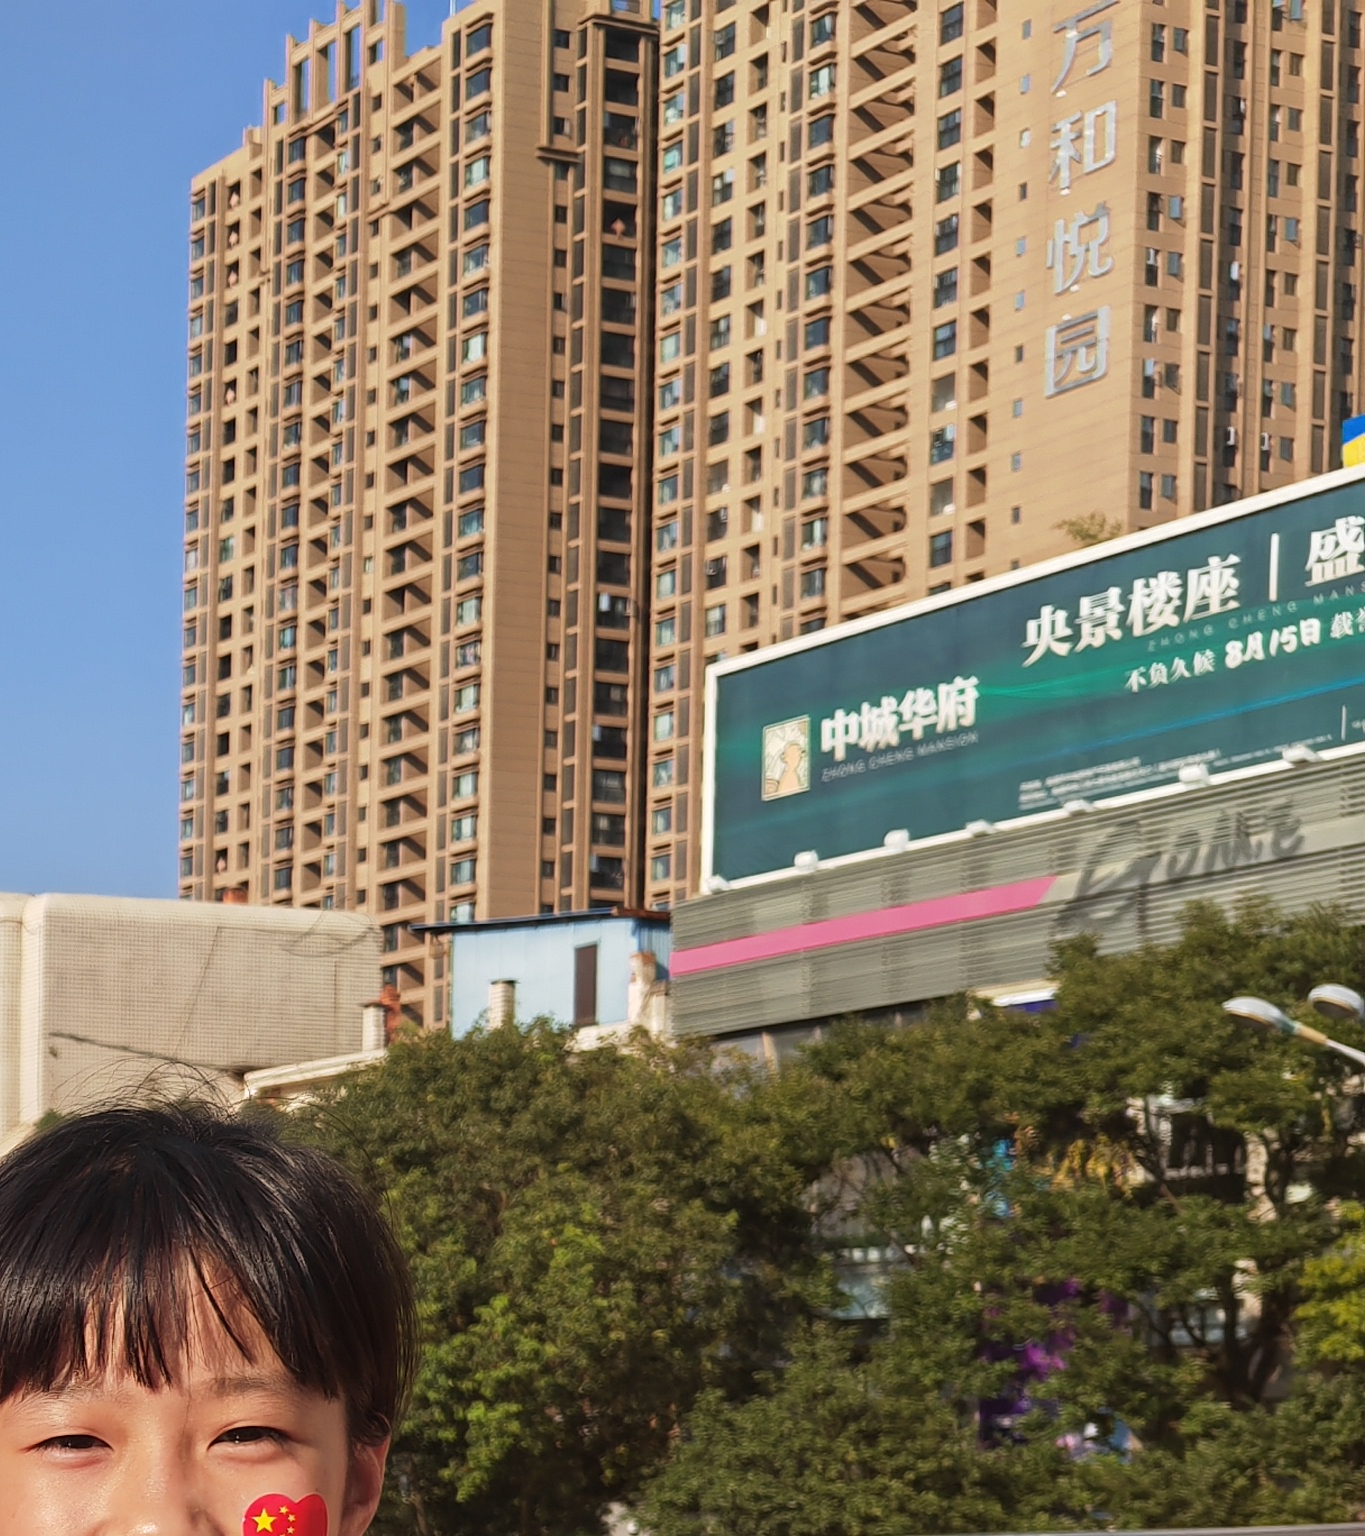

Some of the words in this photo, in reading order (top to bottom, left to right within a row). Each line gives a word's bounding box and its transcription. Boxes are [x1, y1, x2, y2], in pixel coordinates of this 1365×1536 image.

[1045, 0, 1121, 397] 万和悦园
[1021, 554, 1241, 668] 央景楼座
[820, 675, 980, 762] 中城华府
